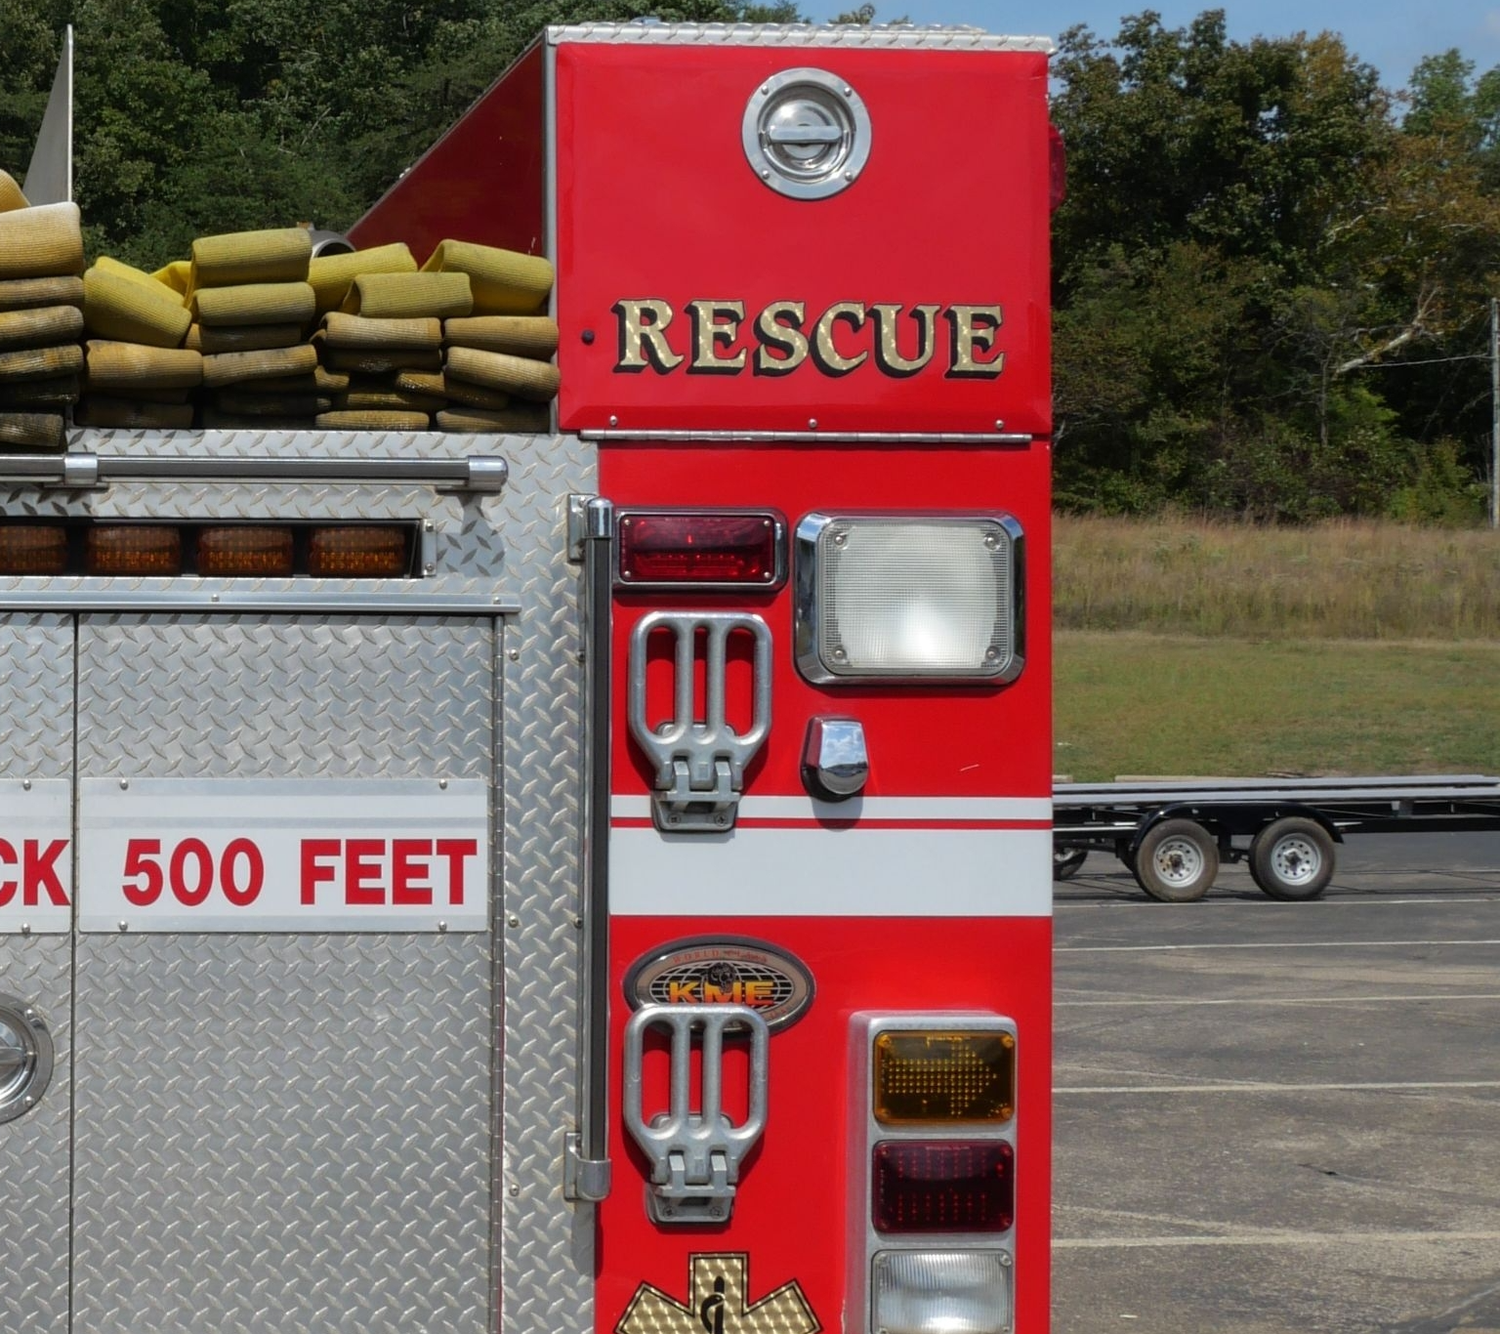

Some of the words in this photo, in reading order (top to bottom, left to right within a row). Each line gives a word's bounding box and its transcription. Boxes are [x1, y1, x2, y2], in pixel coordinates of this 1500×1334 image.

[612, 297, 1005, 380] RESCUE
[121, 837, 265, 907] 500
[300, 838, 478, 906] FEET
[668, 980, 776, 1004] KME
